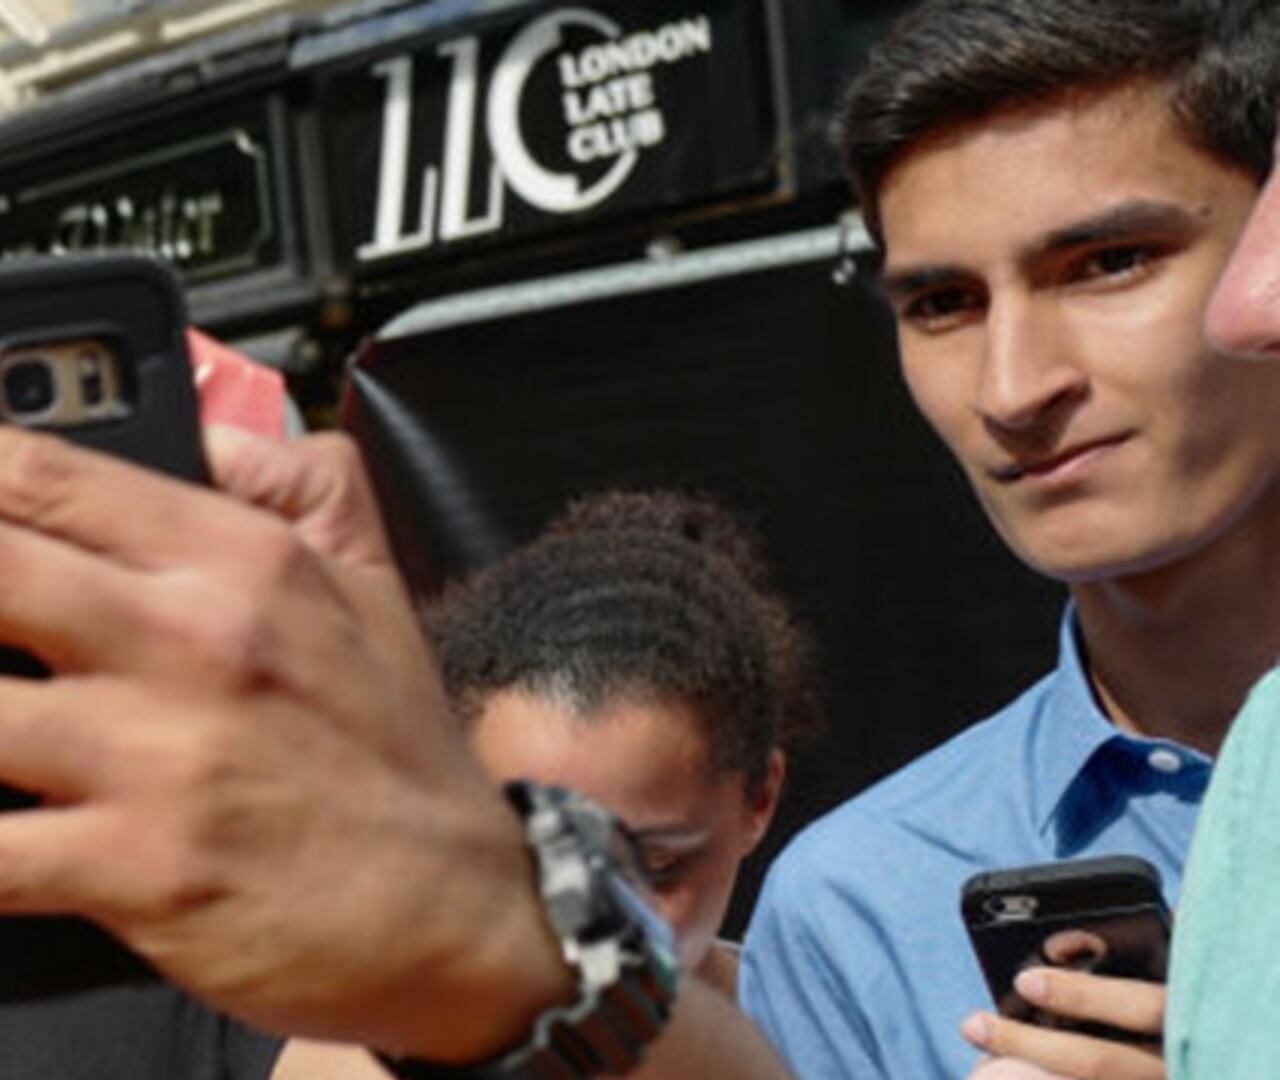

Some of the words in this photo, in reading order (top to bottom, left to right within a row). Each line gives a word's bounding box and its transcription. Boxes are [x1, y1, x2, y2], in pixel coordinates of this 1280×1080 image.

[558, 16, 711, 87] LONDON
[562, 73, 654, 126] LATE
[567, 109, 665, 163] CLUB
